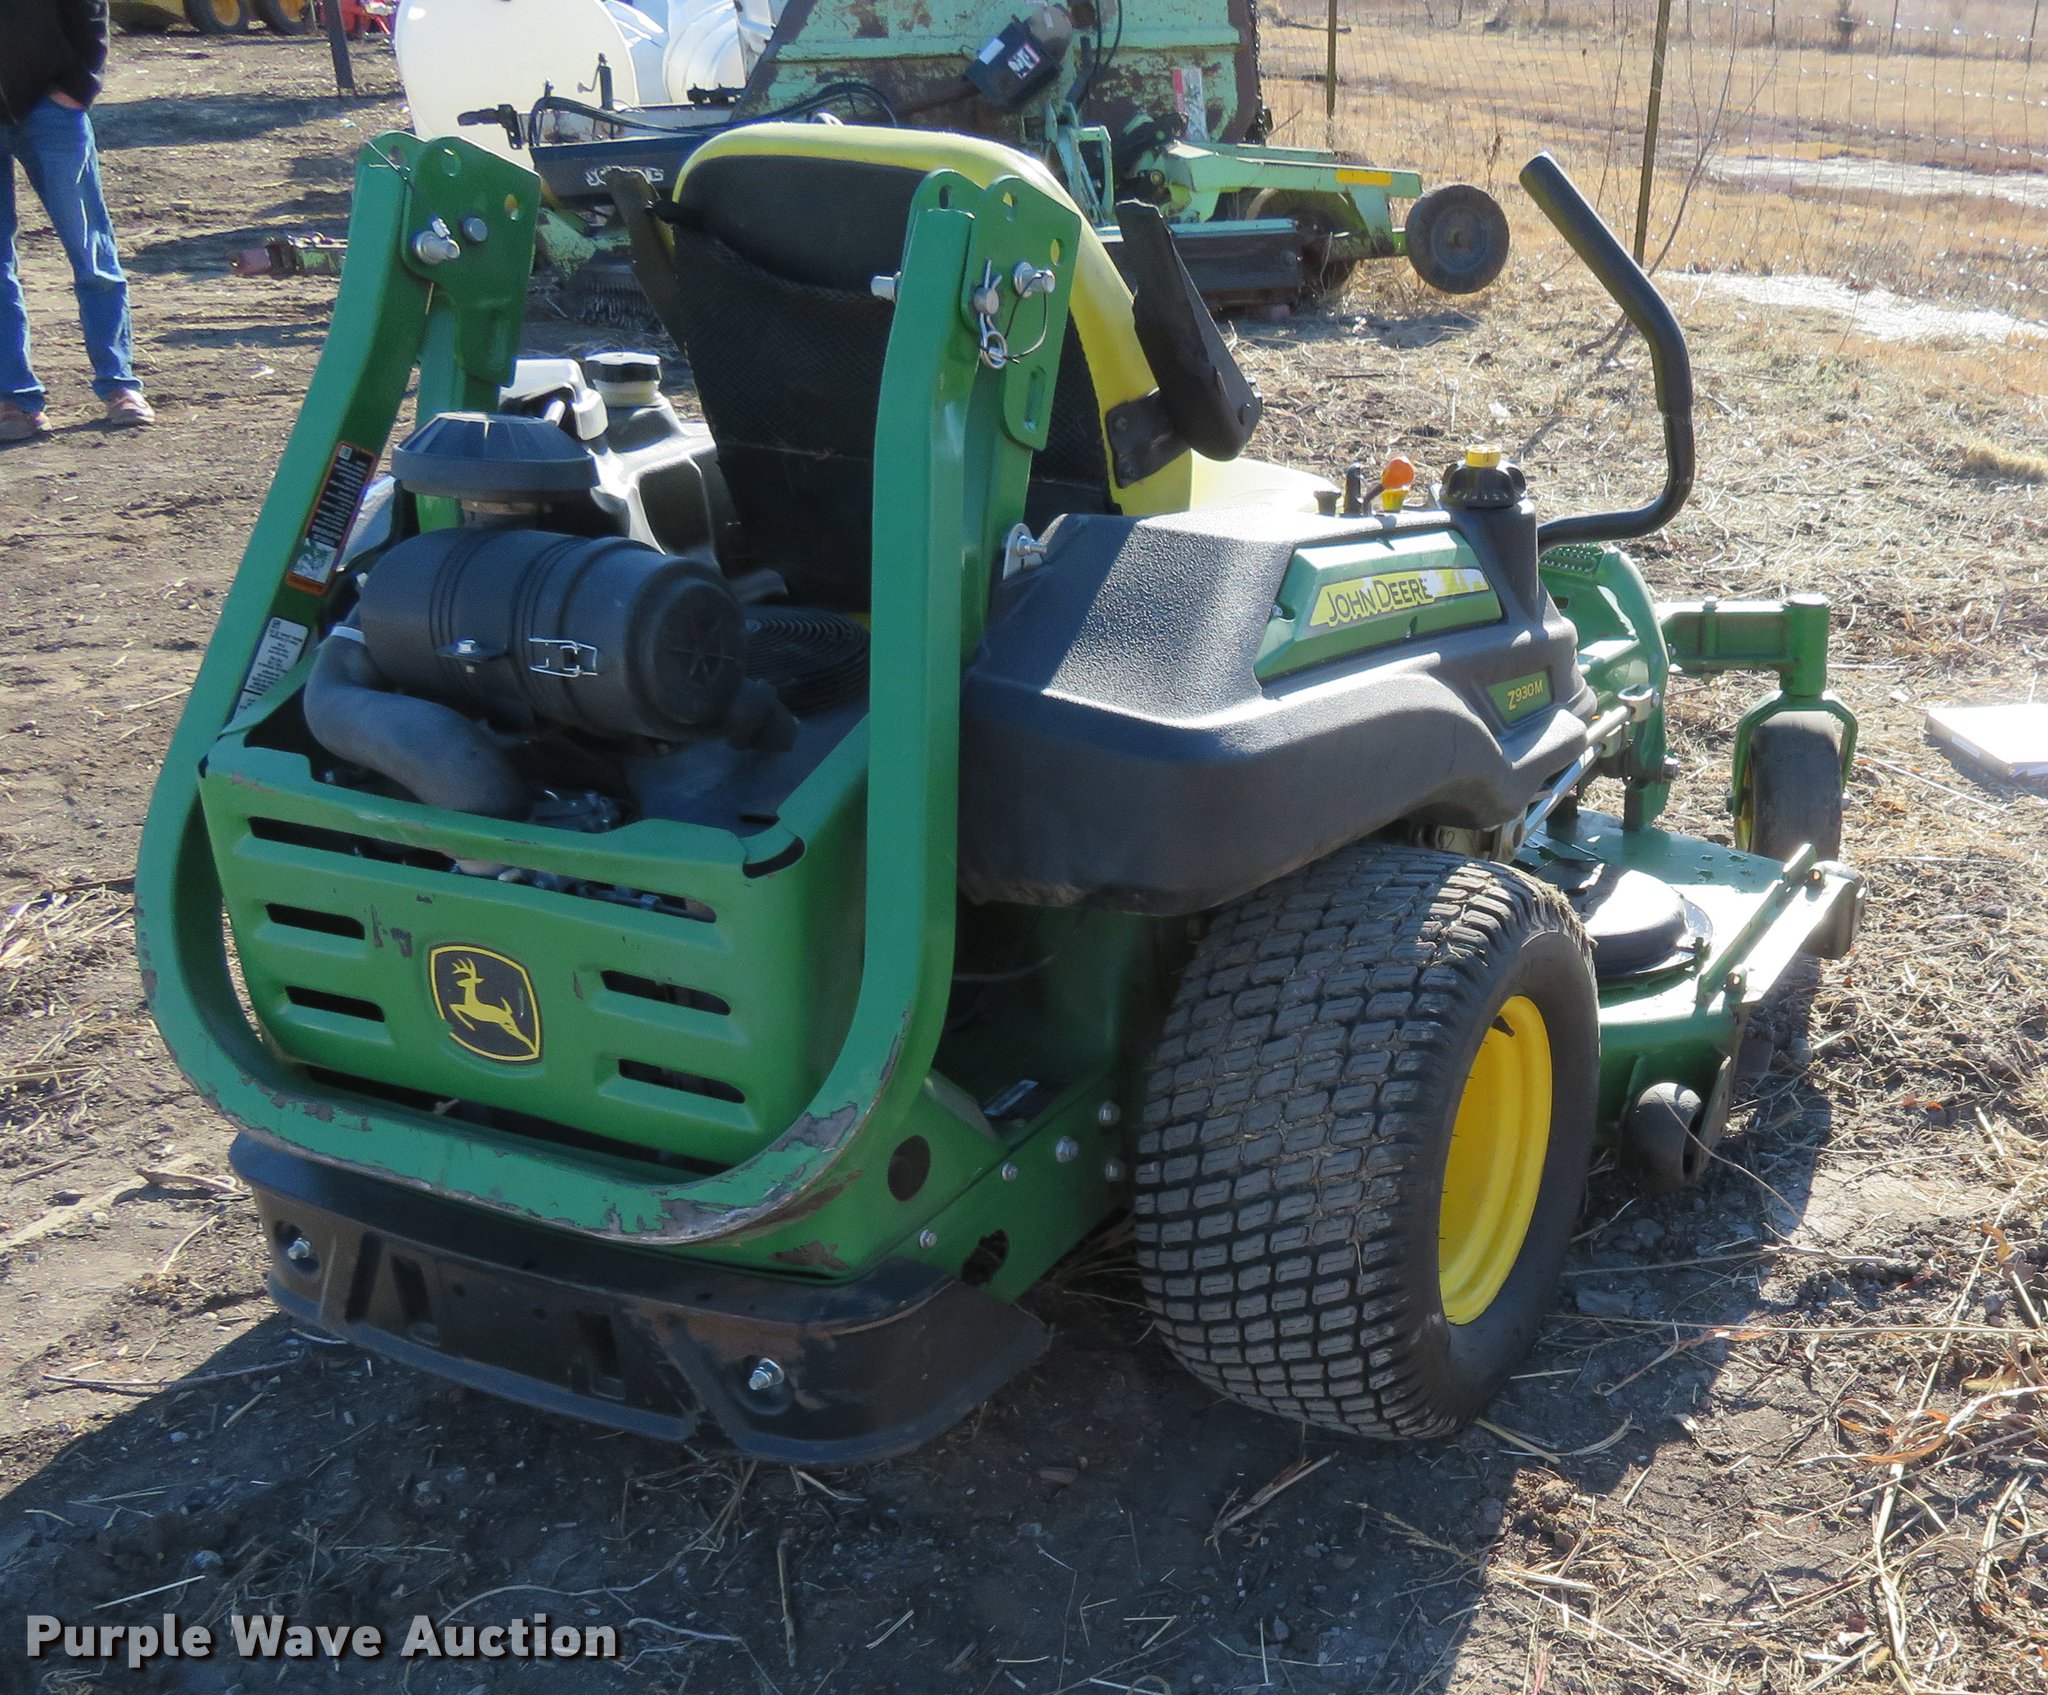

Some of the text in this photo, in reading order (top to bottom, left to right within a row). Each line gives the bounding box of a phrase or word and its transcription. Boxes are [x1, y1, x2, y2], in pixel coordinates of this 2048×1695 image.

[1328, 577, 1433, 623] JOHN DEERE
[1507, 680, 1543, 710] Z930M
